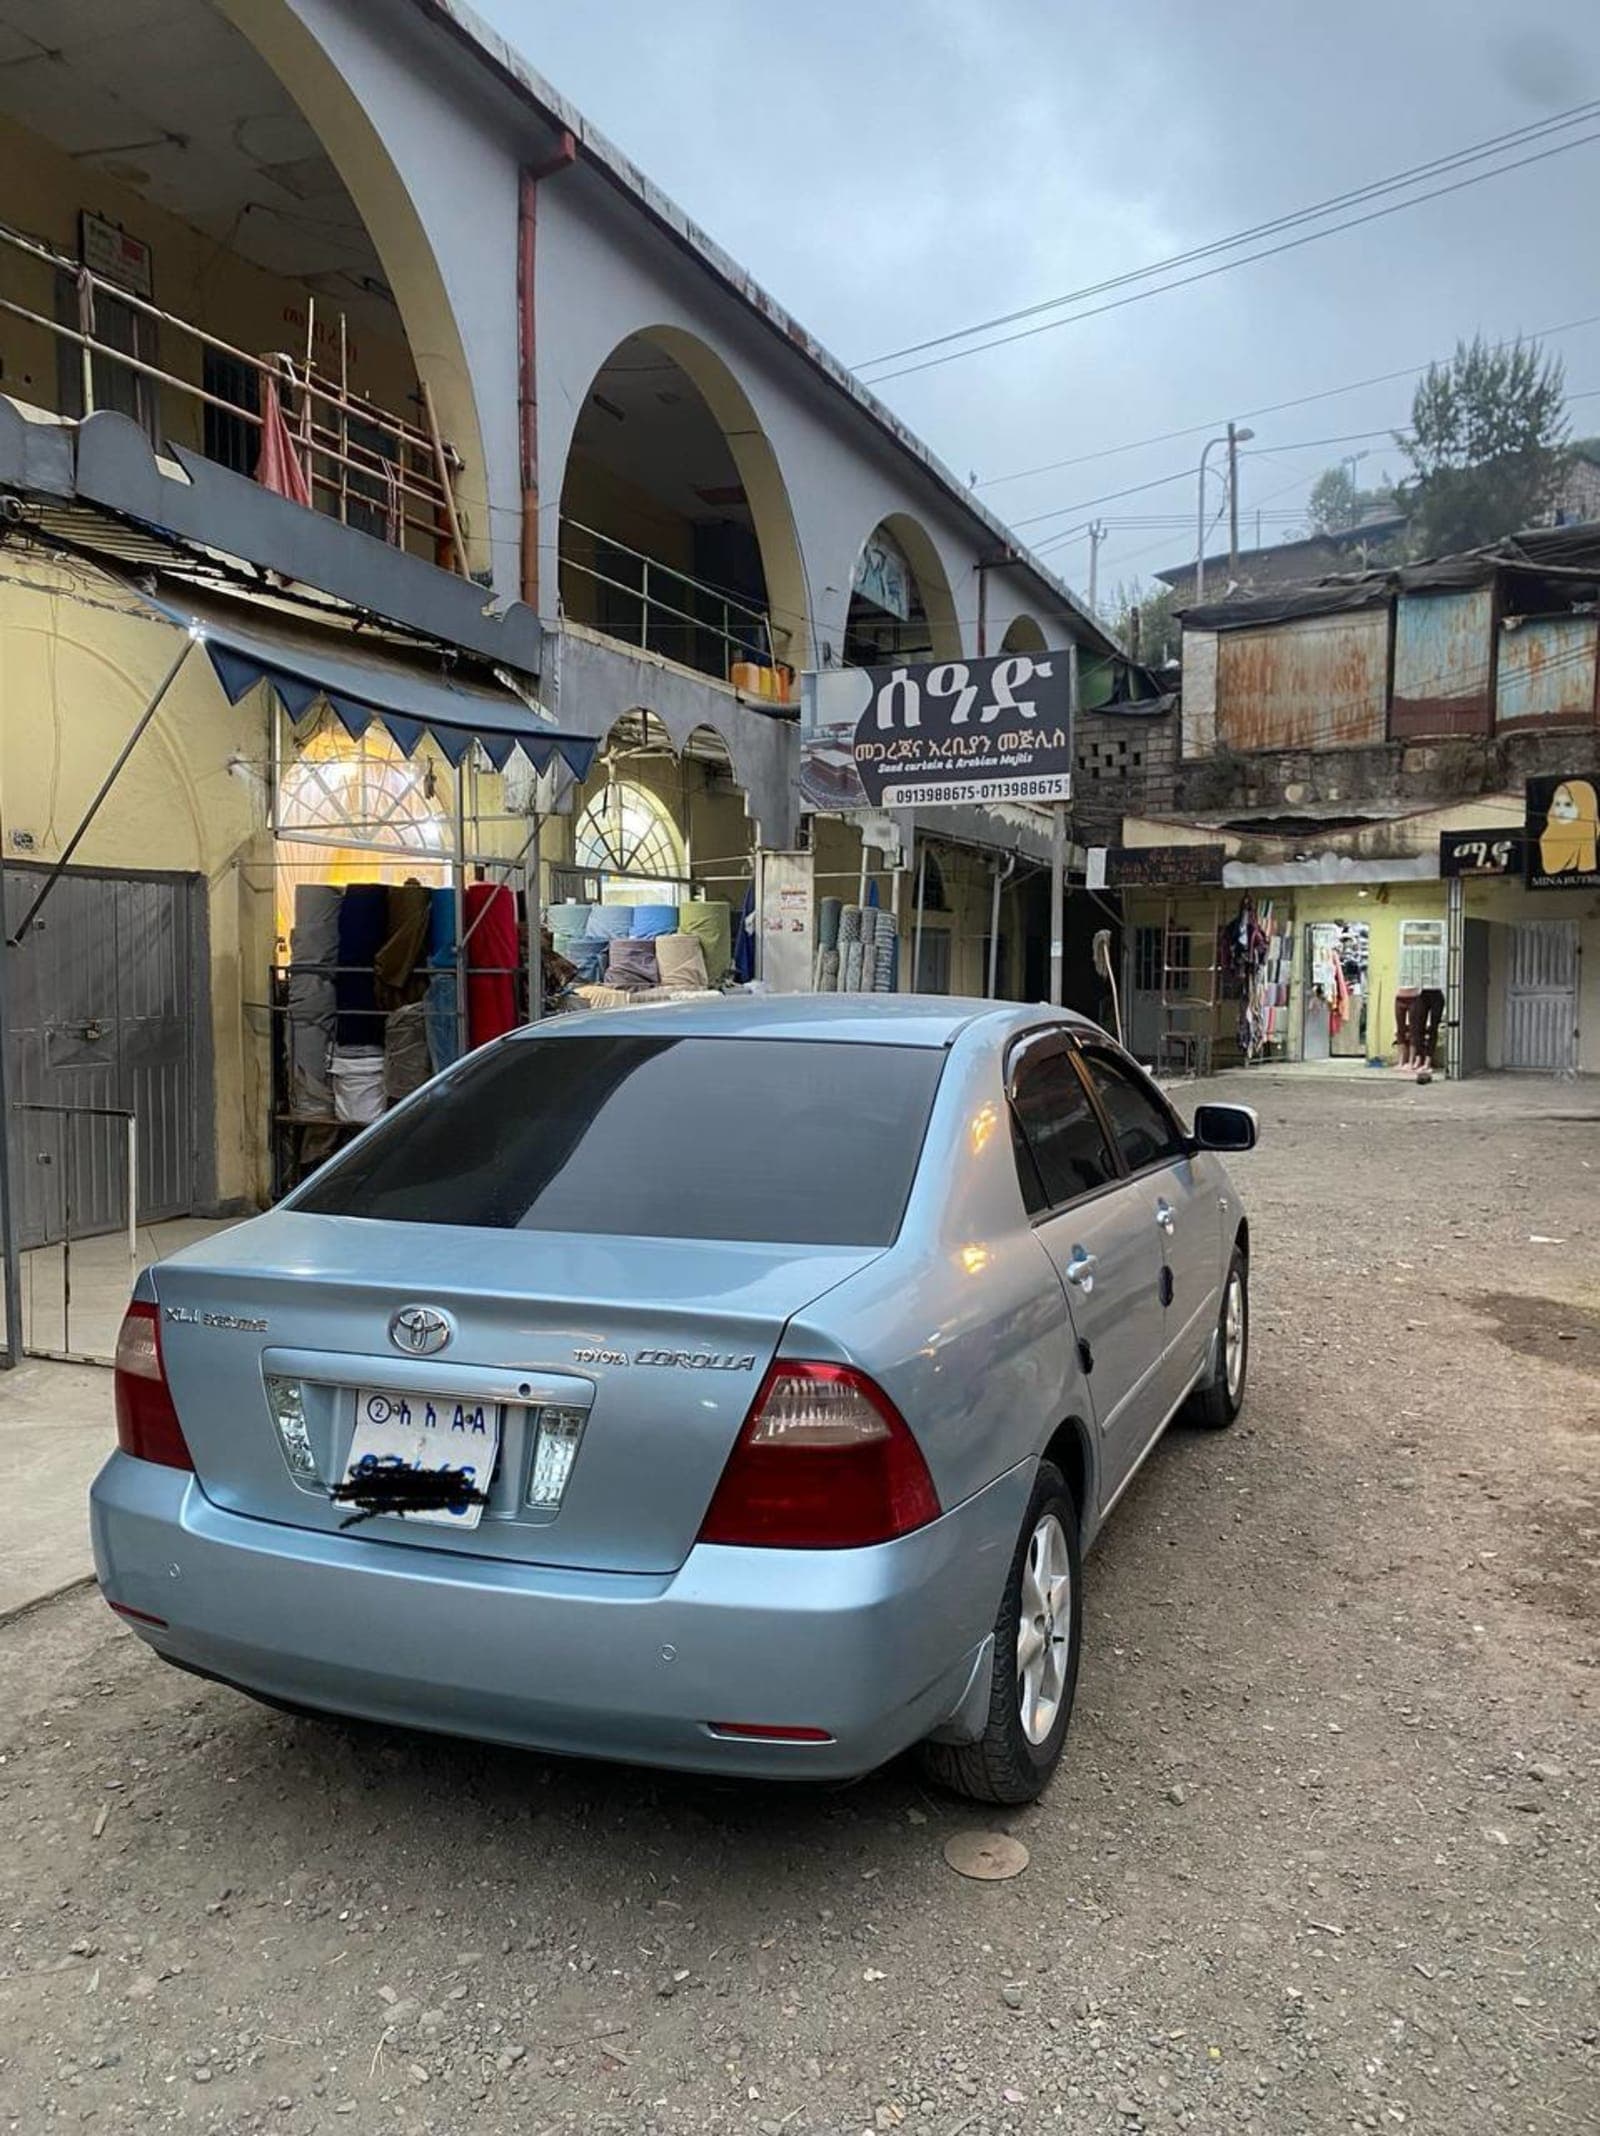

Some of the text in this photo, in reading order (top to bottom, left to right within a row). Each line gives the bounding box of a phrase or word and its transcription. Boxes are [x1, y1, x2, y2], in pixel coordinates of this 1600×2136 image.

[855, 739, 923, 762] መጋረጃና
[997, 727, 1066, 751] መጅሊስ
[904, 757, 944, 772] curtain
[945, 759, 953, 770] &
[955, 755, 998, 768] Arabian
[999, 752, 1034, 767] Majlis
[896, 779, 1063, 804] 0913988675-0713988675
[573, 1348, 757, 1371] TOYOTA COROLLA
